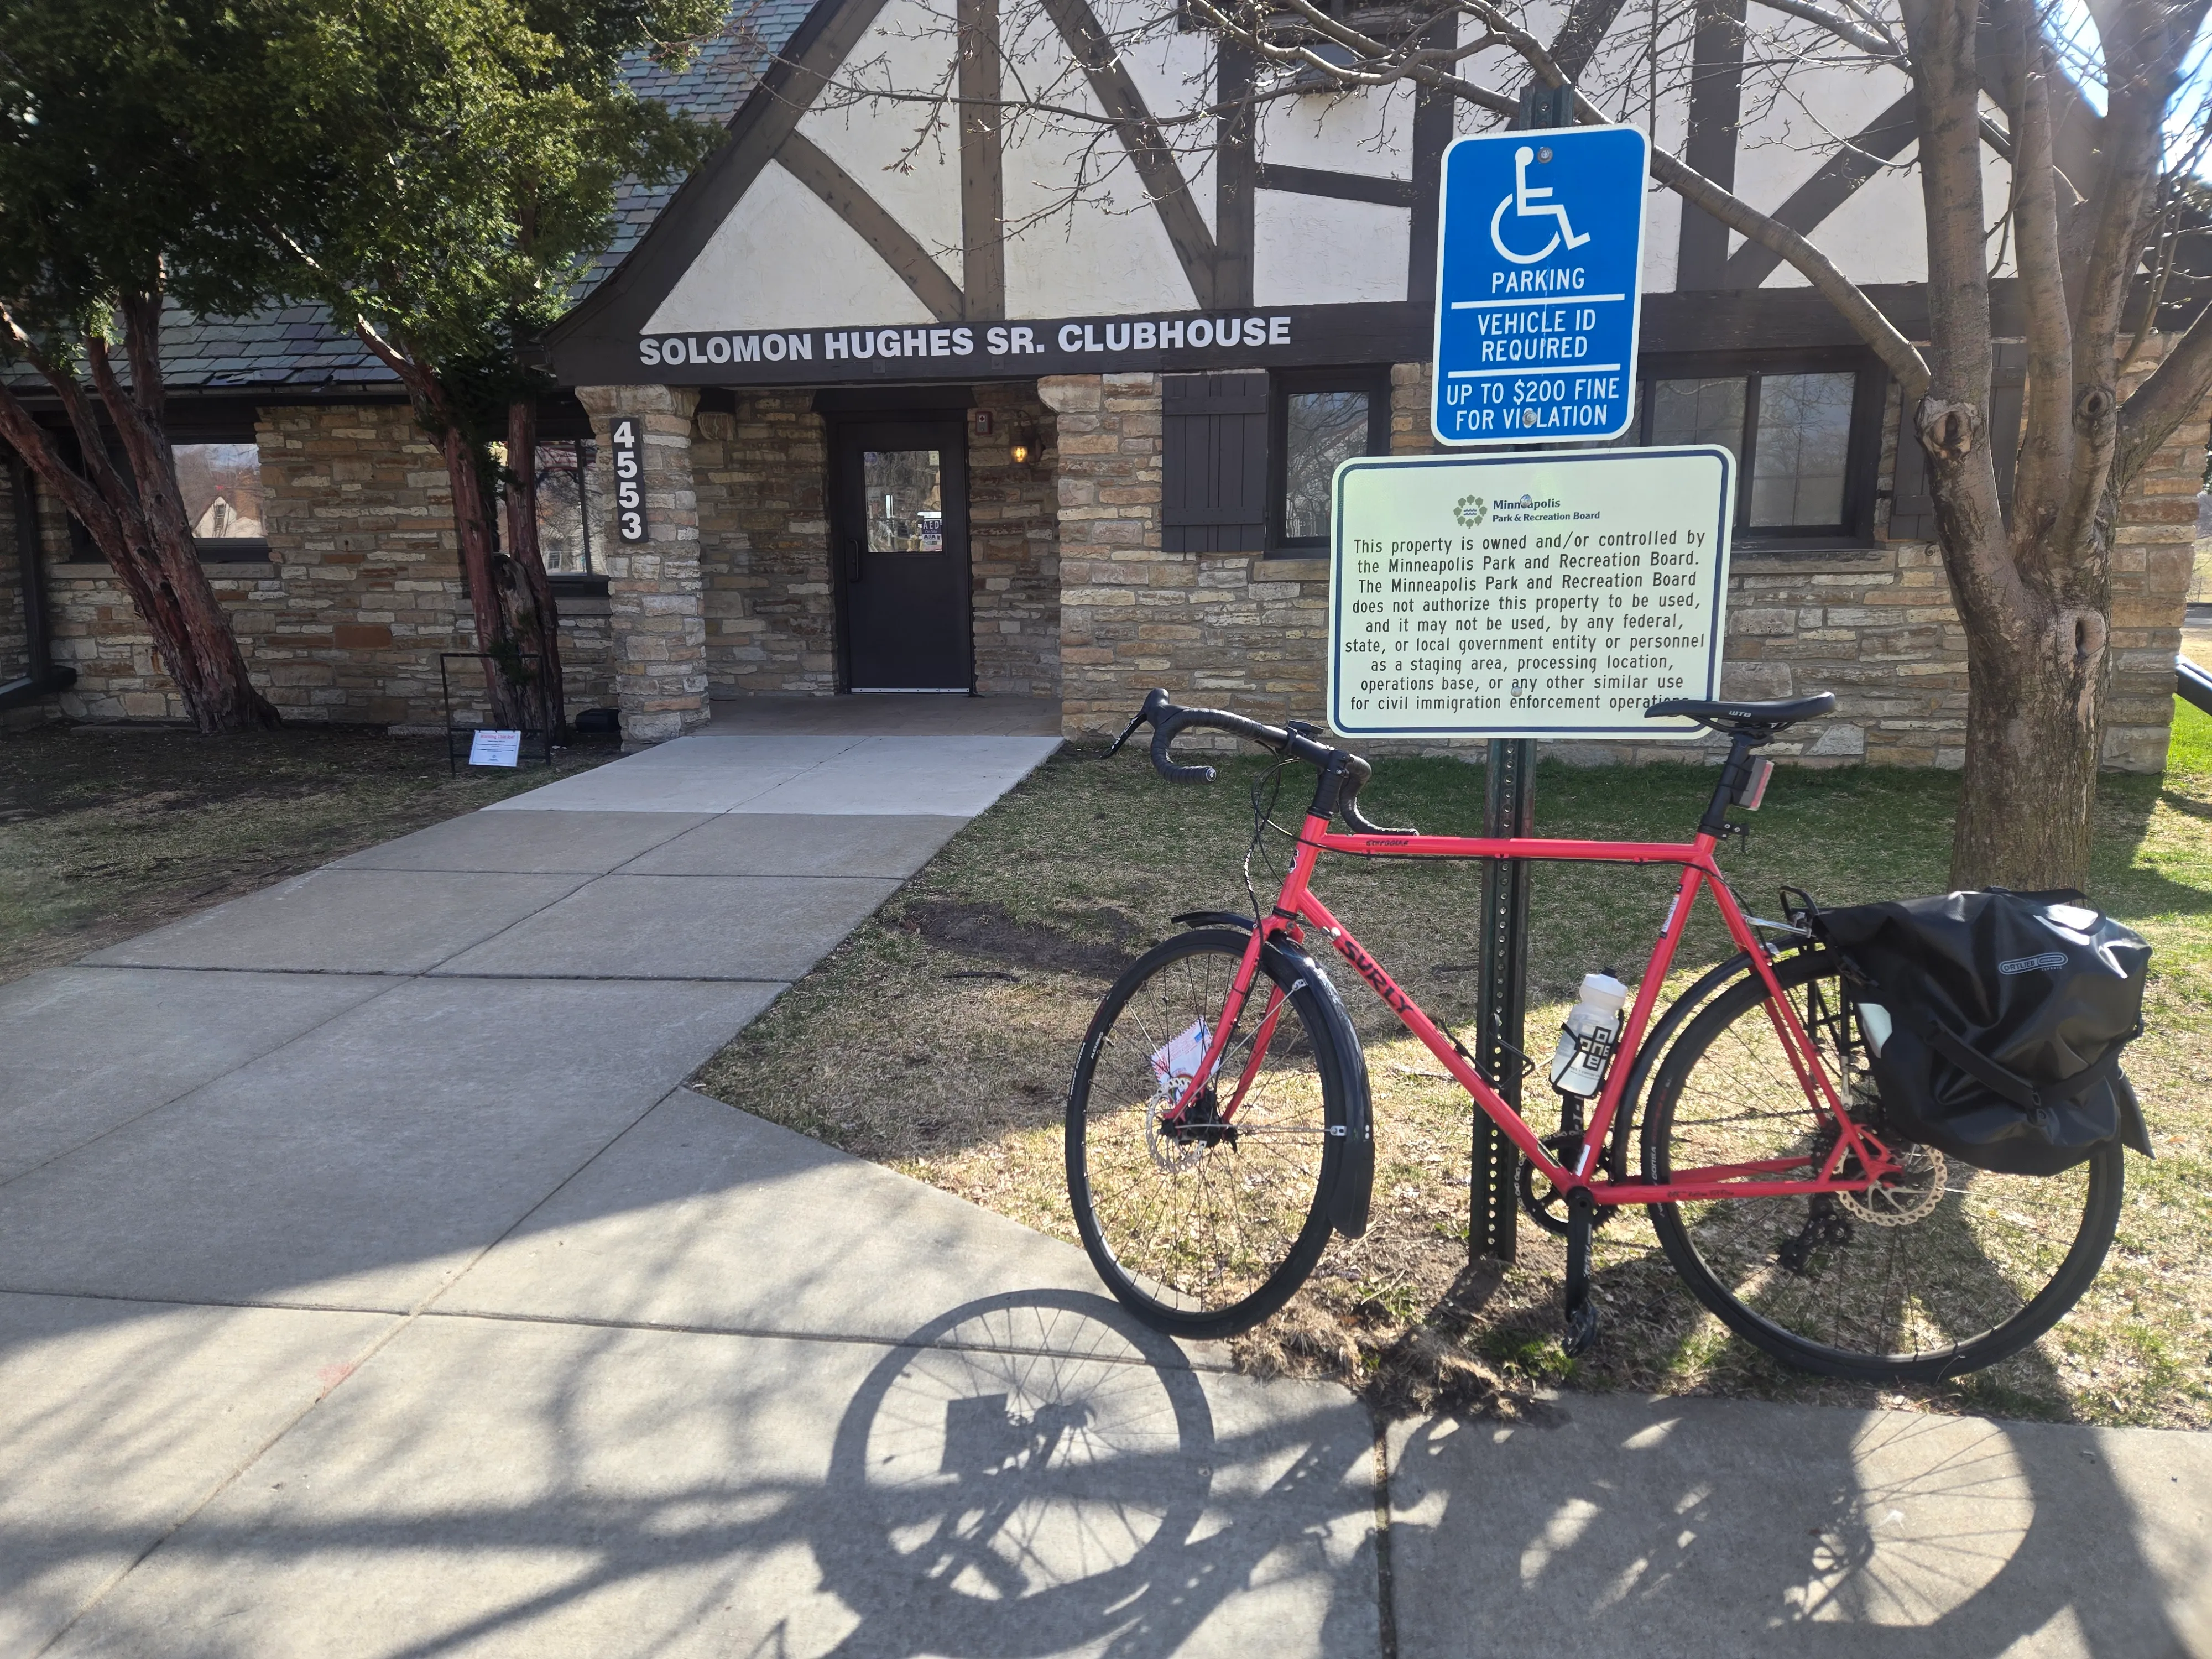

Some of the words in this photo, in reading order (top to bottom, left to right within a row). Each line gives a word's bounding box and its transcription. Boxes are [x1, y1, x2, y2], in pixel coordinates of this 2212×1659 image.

[1492, 268, 1584, 293] PARKING
[1478, 311, 1566, 335] VEHICLE
[1576, 309, 1595, 330] ID
[640, 334, 812, 364] SOLOMON
[825, 328, 973, 359] HUGHES
[987, 327, 1044, 354] SR.
[1058, 317, 1290, 352] CLUBHOUSE
[1482, 336, 1587, 362] REQUIRED
[1447, 384, 1472, 405] UP
[1481, 383, 1504, 404] TO
[1513, 379, 1565, 405] $200
[1575, 378, 1619, 400] FINE
[1457, 410, 1494, 430] FOR
[614, 422, 641, 539] 4553
[1493, 498, 1561, 510] Minnapolis
[1524, 513, 1570, 521] Recreation
[1573, 511, 1600, 519] Board
[1354, 539, 1382, 553] This
[1392, 538, 1452, 556] property
[1462, 536, 1473, 550] is
[1483, 535, 1526, 550] owned
[1536, 531, 1589, 549] and/or
[1599, 530, 1677, 546] controlled
[1687, 530, 1705, 547] by
[1358, 560, 1379, 573] the
[1389, 557, 1473, 575] Minneapolis
[1483, 556, 1515, 570] Park
[1525, 555, 1549, 569] and
[1559, 553, 1640, 568] Recreation
[1651, 551, 1699, 566] Board.
[1359, 580, 1382, 593] The
[1392, 577, 1476, 594] Minneapolis
[1486, 576, 1518, 590] Park
[1527, 575, 1552, 589] and
[1562, 573, 1642, 588] Recreation
[1653, 571, 1696, 586] Board
[1353, 599, 1383, 613] does
[1393, 598, 1414, 612] not
[1423, 597, 1489, 611] authorize
[1499, 596, 1526, 609] this
[1536, 594, 1599, 613] property
[1609, 594, 1622, 608] to
[1632, 593, 1648, 607] be
[1659, 592, 1699, 609] used,
[1366, 619, 1389, 632] and
[1400, 618, 1408, 632] it
[1418, 620, 1447, 634] may
[1456, 617, 1477, 630] not
[1487, 617, 1502, 630] be
[1512, 615, 1550, 632] used,
[1561, 615, 1578, 632] by
[1587, 618, 1614, 632] any
[1624, 613, 1683, 630] federal,
[1345, 639, 1385, 654] state,
[1395, 641, 1408, 651] or
[1417, 638, 1449, 651] local
[1459, 636, 1543, 655] government
[1553, 635, 1596, 653] entity
[1606, 638, 1620, 648] or
[1630, 634, 1704, 651] personnel
[1371, 661, 1386, 671] as
[1395, 661, 1402, 671] a
[1411, 658, 1461, 675] staging
[1471, 659, 1507, 672] area,
[1518, 655, 1597, 673] processing
[1608, 654, 1673, 671] location,
[1361, 677, 1433, 694] operations
[1442, 677, 1479, 692] base,
[1489, 679, 1503, 689] or
[1511, 678, 1537, 692] any
[1547, 676, 1585, 688] other
[1594, 675, 1648, 688] similar
[1658, 677, 1683, 688] use
[1351, 697, 1369, 710] for
[1378, 696, 1407, 709] civil
[1417, 696, 1500, 713] immigration
[1510, 695, 1600, 708] enforcement
[1339, 941, 1414, 1013] SURLY
[2004, 961, 2035, 971] ORTLIEB
